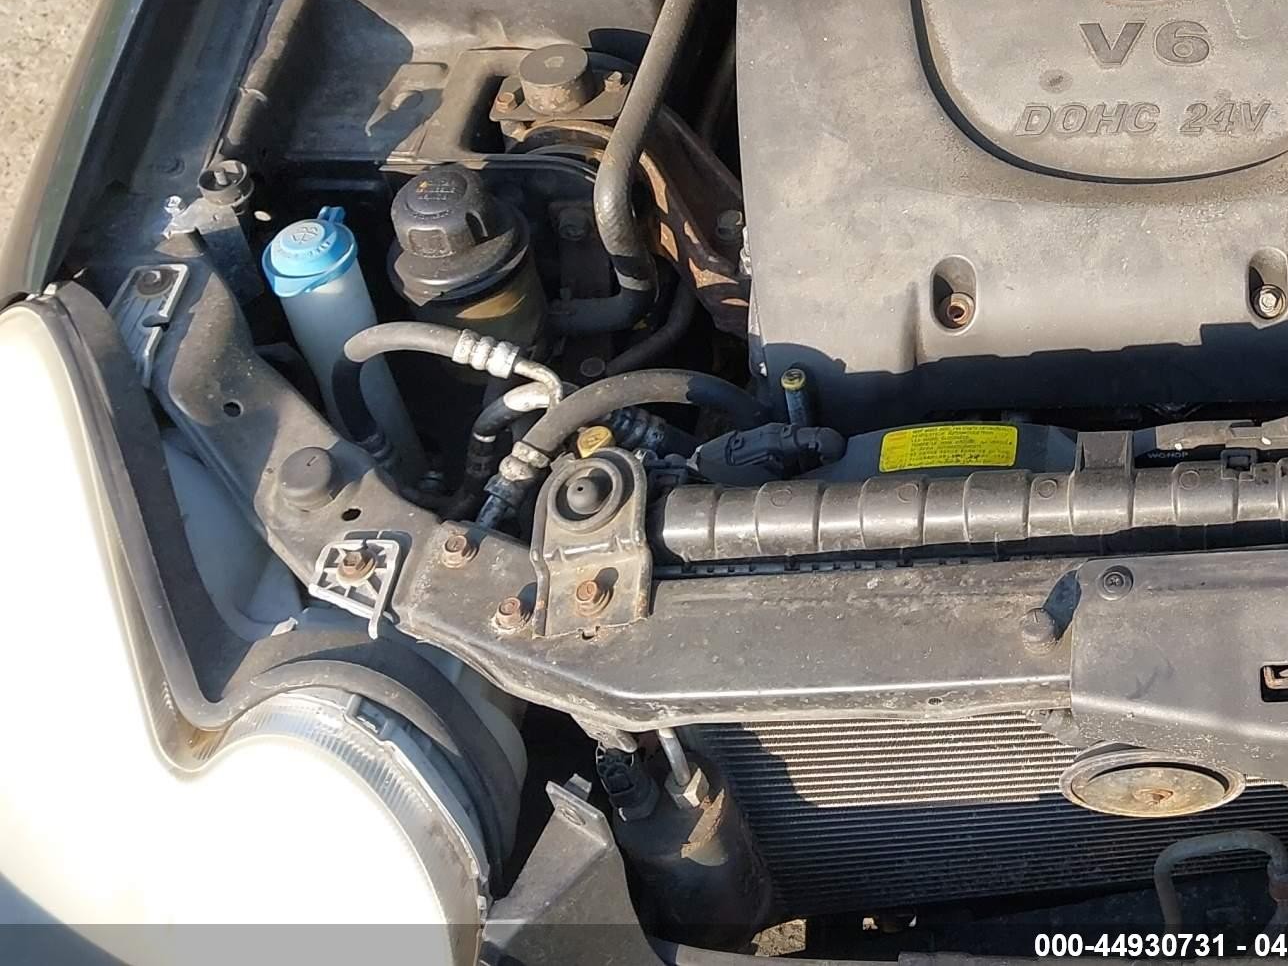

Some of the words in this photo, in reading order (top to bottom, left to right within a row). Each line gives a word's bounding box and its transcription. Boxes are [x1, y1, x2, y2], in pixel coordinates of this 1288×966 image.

[1079, 20, 1210, 66] V6
[1016, 103, 1160, 137] DOHC
[1179, 102, 1272, 134] 24V
